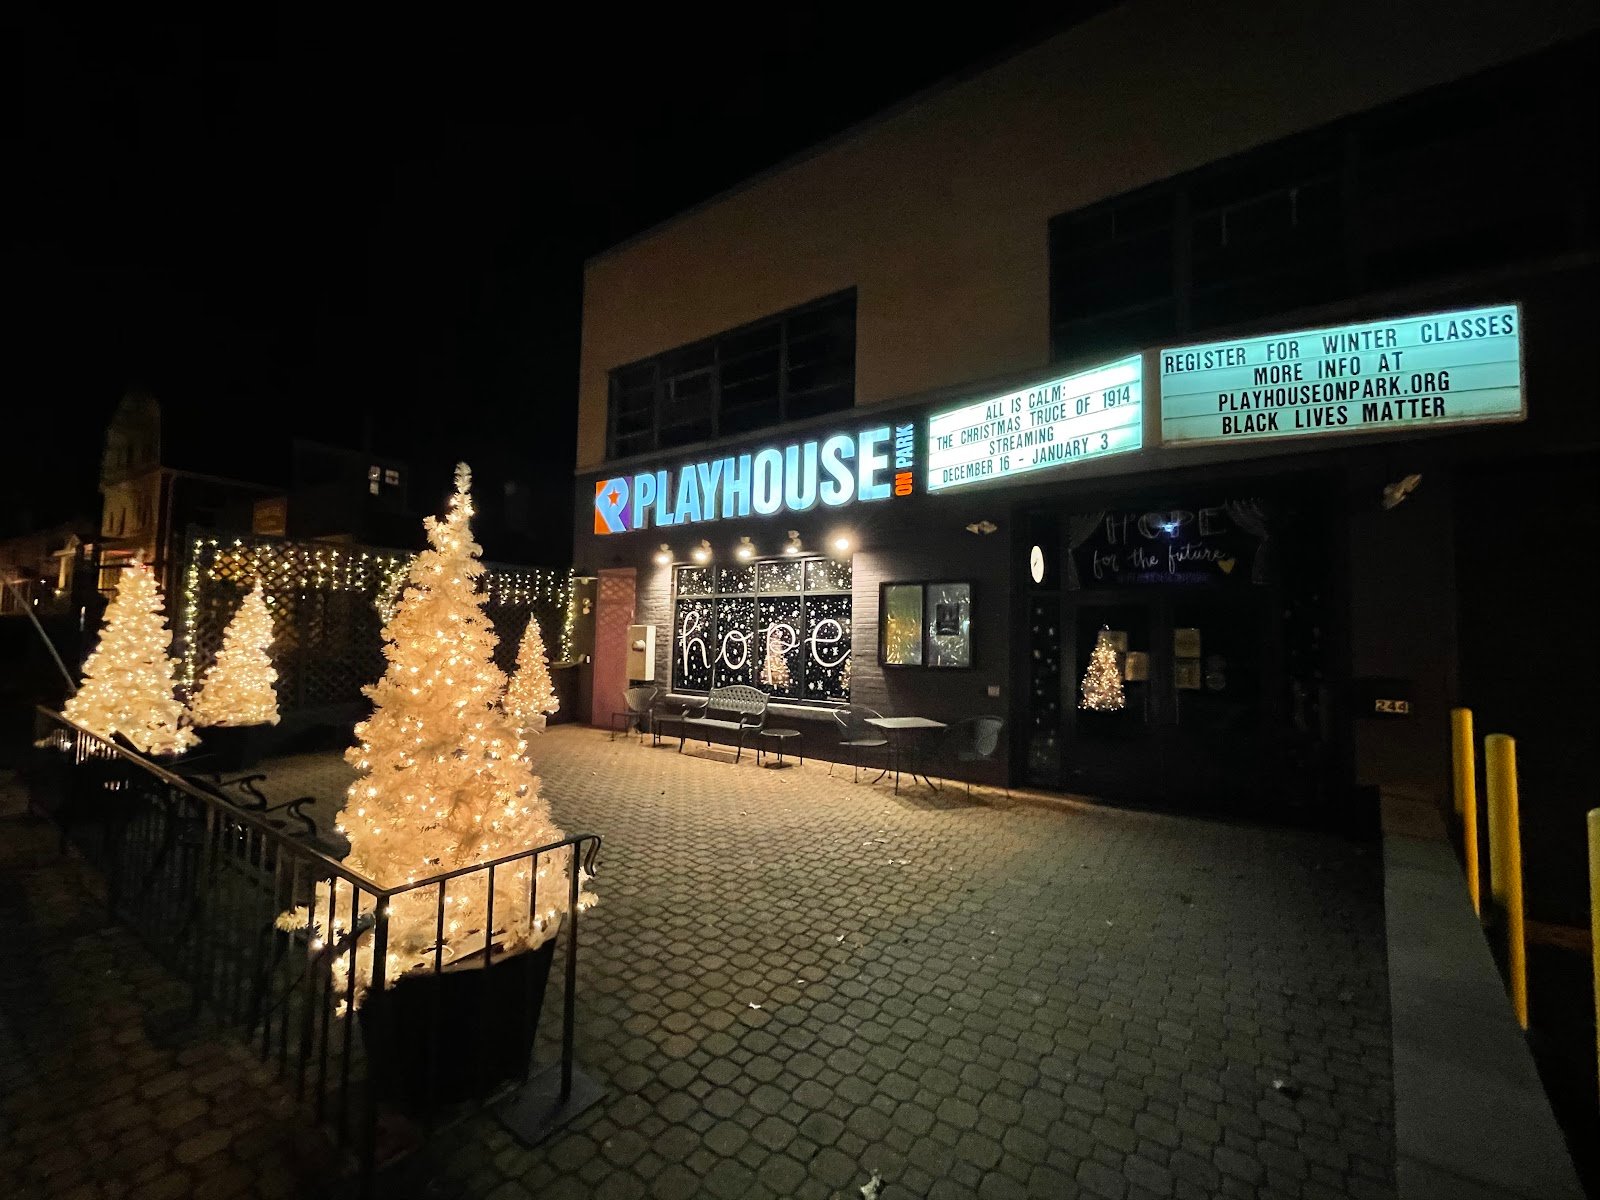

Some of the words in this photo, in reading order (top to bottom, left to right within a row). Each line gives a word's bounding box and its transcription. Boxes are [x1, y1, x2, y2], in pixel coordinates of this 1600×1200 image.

[1165, 347, 1246, 373] REGISTER
[1267, 341, 1299, 361] FOR
[1322, 328, 1397, 355] WINTER
[1420, 314, 1513, 343] CLASSES
[1254, 363, 1303, 386] MORE
[1318, 356, 1361, 378] INFO
[1378, 352, 1403, 372] AT
[985, 403, 1005, 421] ALL
[1011, 397, 1022, 414] IS
[1028, 385, 1066, 409] CALM:
[1218, 371, 1450, 412] PLAYHOUSEONPARK.ORG
[937, 434, 953, 450] THE
[960, 416, 1021, 445] CHRISTMAS
[1029, 403, 1067, 427] TRUCE
[1076, 396, 1091, 415] OF
[1102, 385, 1131, 409] 1914
[1222, 411, 1279, 434] BLACK
[1295, 405, 1348, 428] LIVES
[1362, 397, 1446, 422] MATTER
[895, 422, 914, 468] PARK
[943, 461, 993, 483] DECEMBER
[999, 455, 1010, 472] 16
[1032, 437, 1089, 465] JANUARY
[1100, 433, 1109, 450] 3
[989, 426, 1054, 456] STREAMING
[632, 426, 892, 529] PLAYHOUSE
[895, 471, 912, 496] ON
[1093, 549, 1119, 579] for
[1127, 547, 1159, 568] the
[678, 610, 852, 685] hope
[1374, 699, 1409, 714] 244
